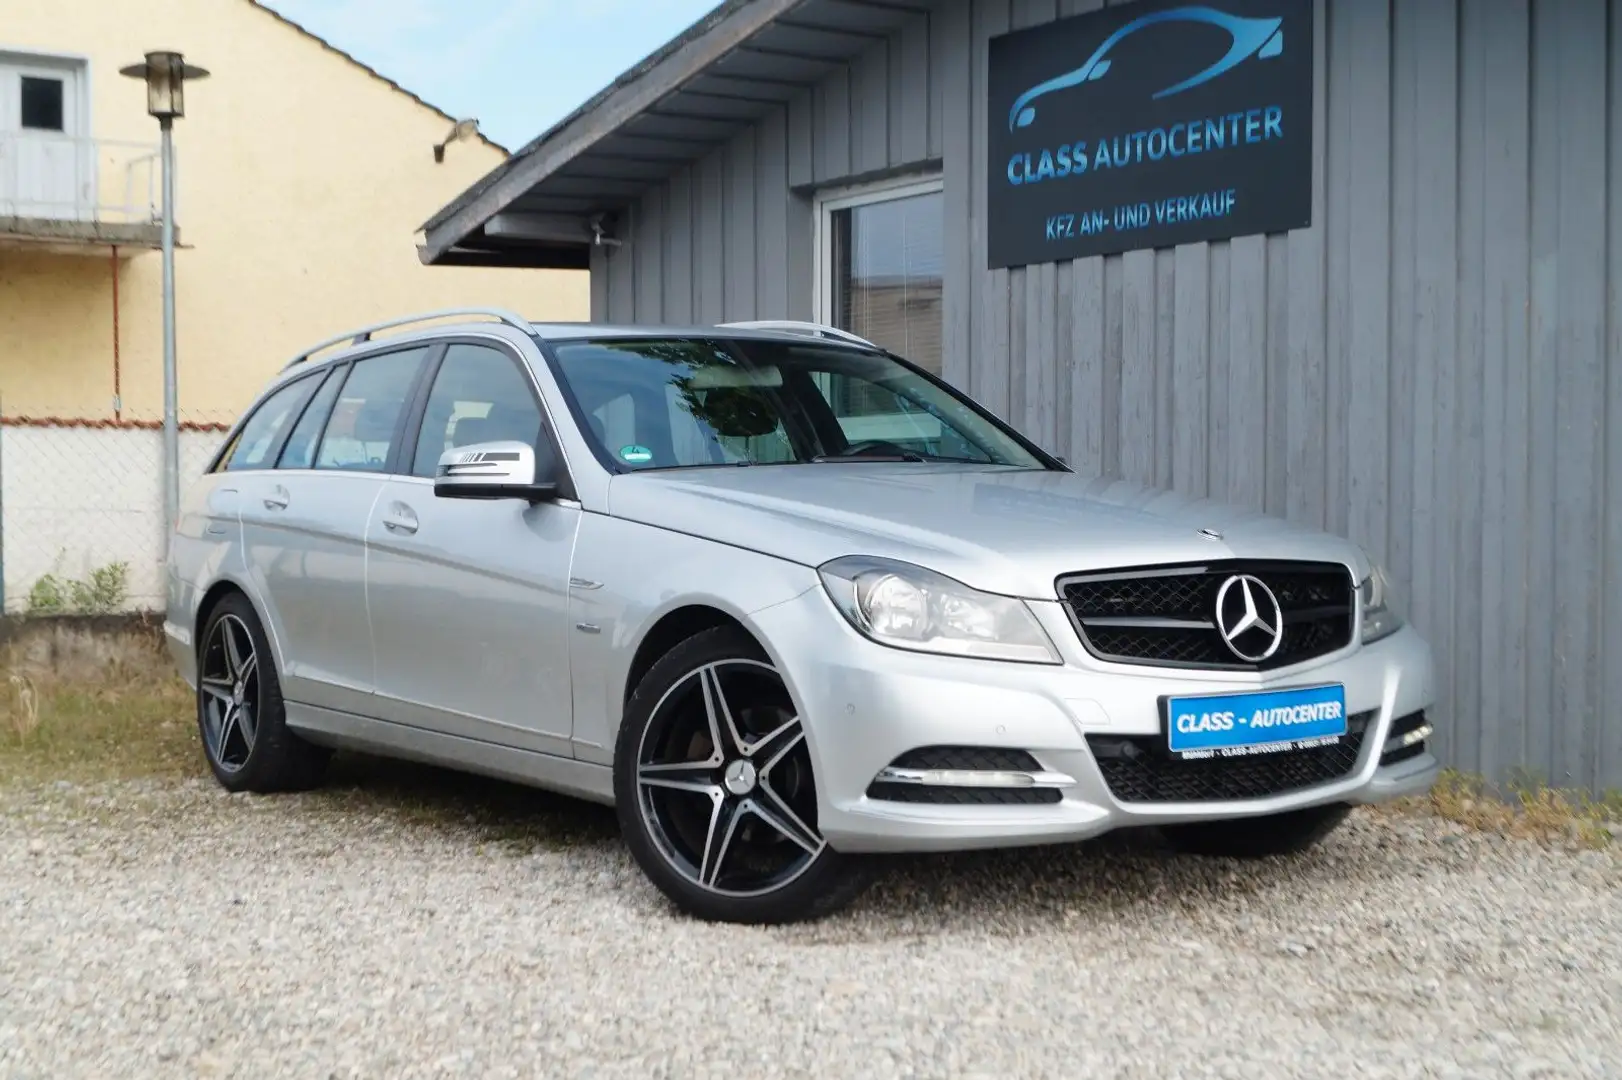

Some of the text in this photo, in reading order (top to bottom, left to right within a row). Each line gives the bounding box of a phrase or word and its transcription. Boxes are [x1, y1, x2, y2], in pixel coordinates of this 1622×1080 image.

[1007, 105, 1284, 185] CLASS AUTOCENTER
[1045, 189, 1236, 241] KFZ AN- UND VERKAUF
[1176, 711, 1234, 733] CLASS
[1250, 700, 1342, 728] AUTOCENTER
